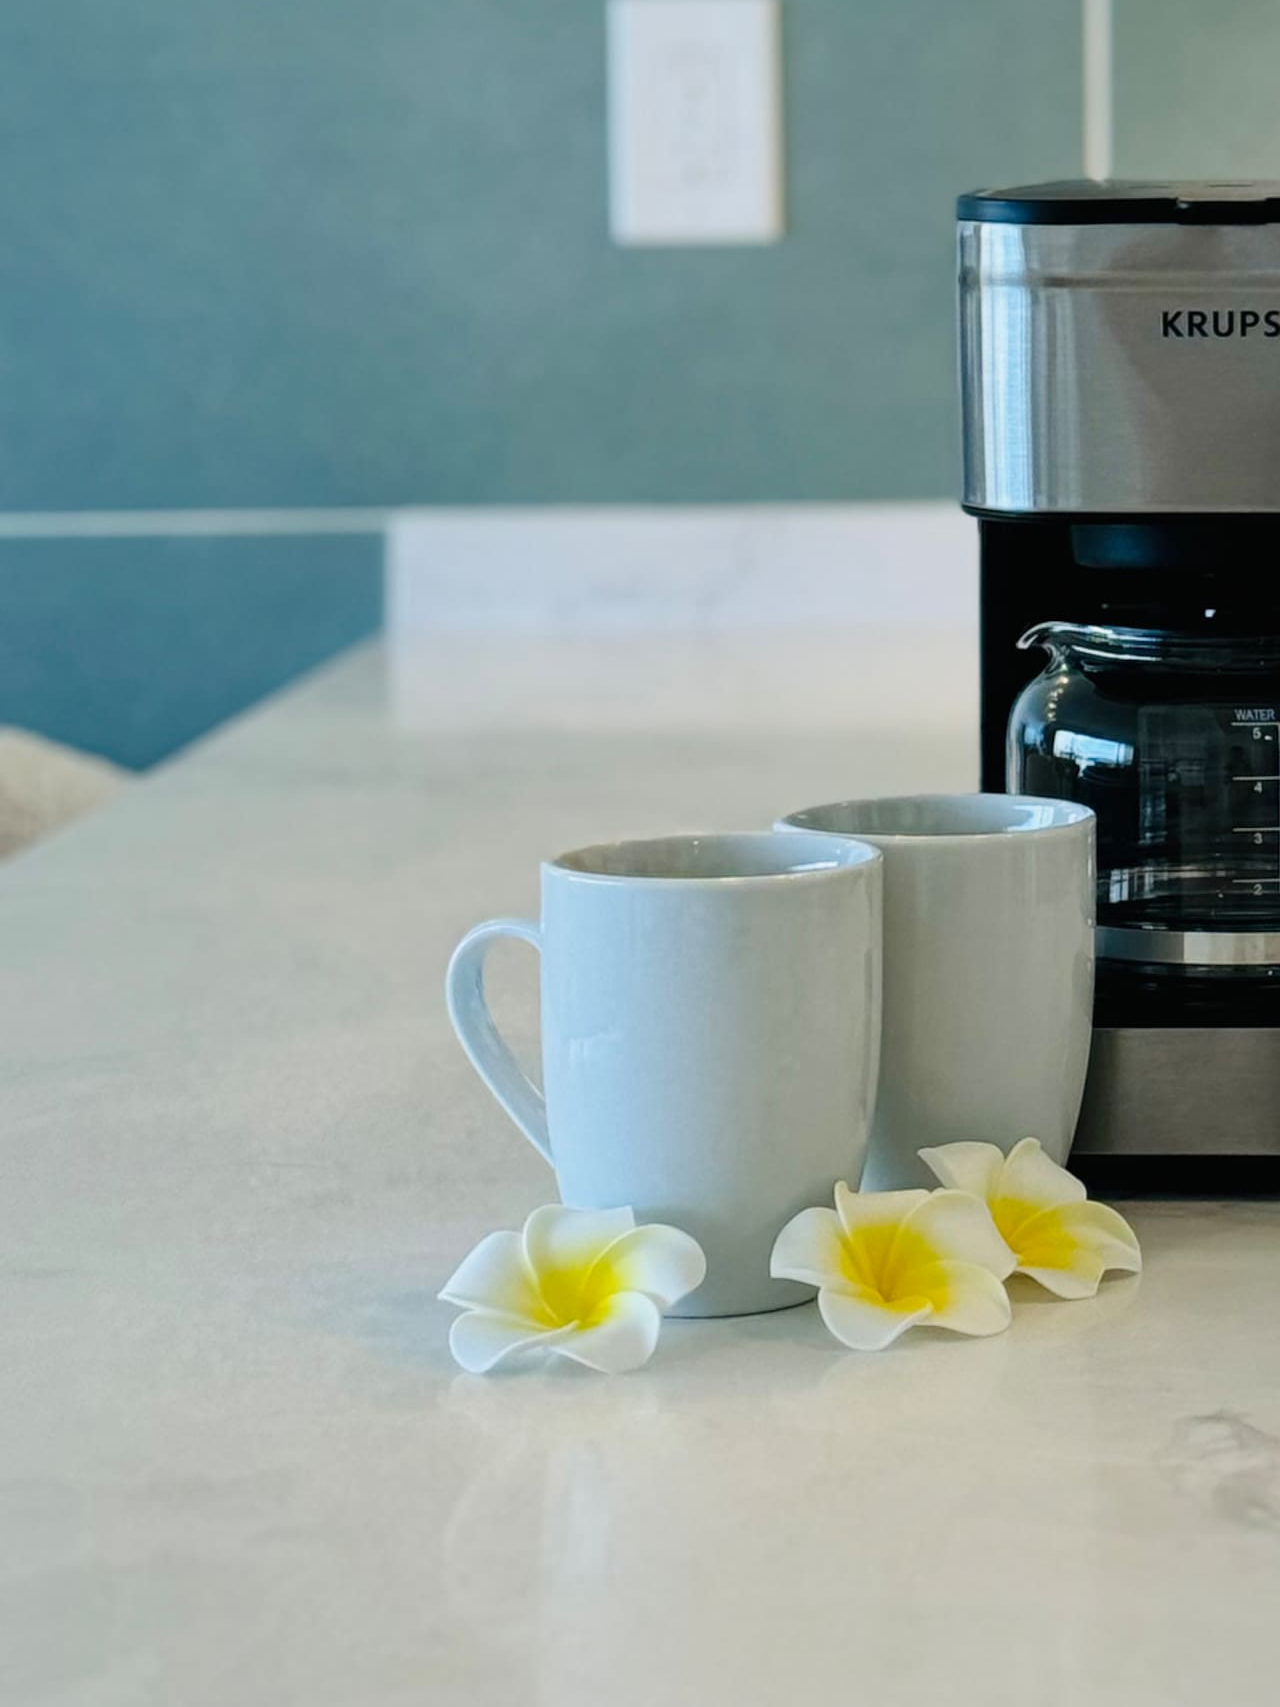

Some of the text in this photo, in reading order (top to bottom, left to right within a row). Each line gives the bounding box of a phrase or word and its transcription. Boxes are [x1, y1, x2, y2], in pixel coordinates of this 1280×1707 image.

[1233, 709, 1276, 721] WATER
[1254, 782, 1263, 793] 4
[1254, 833, 1263, 844] 3
[1254, 884, 1263, 896] 2
